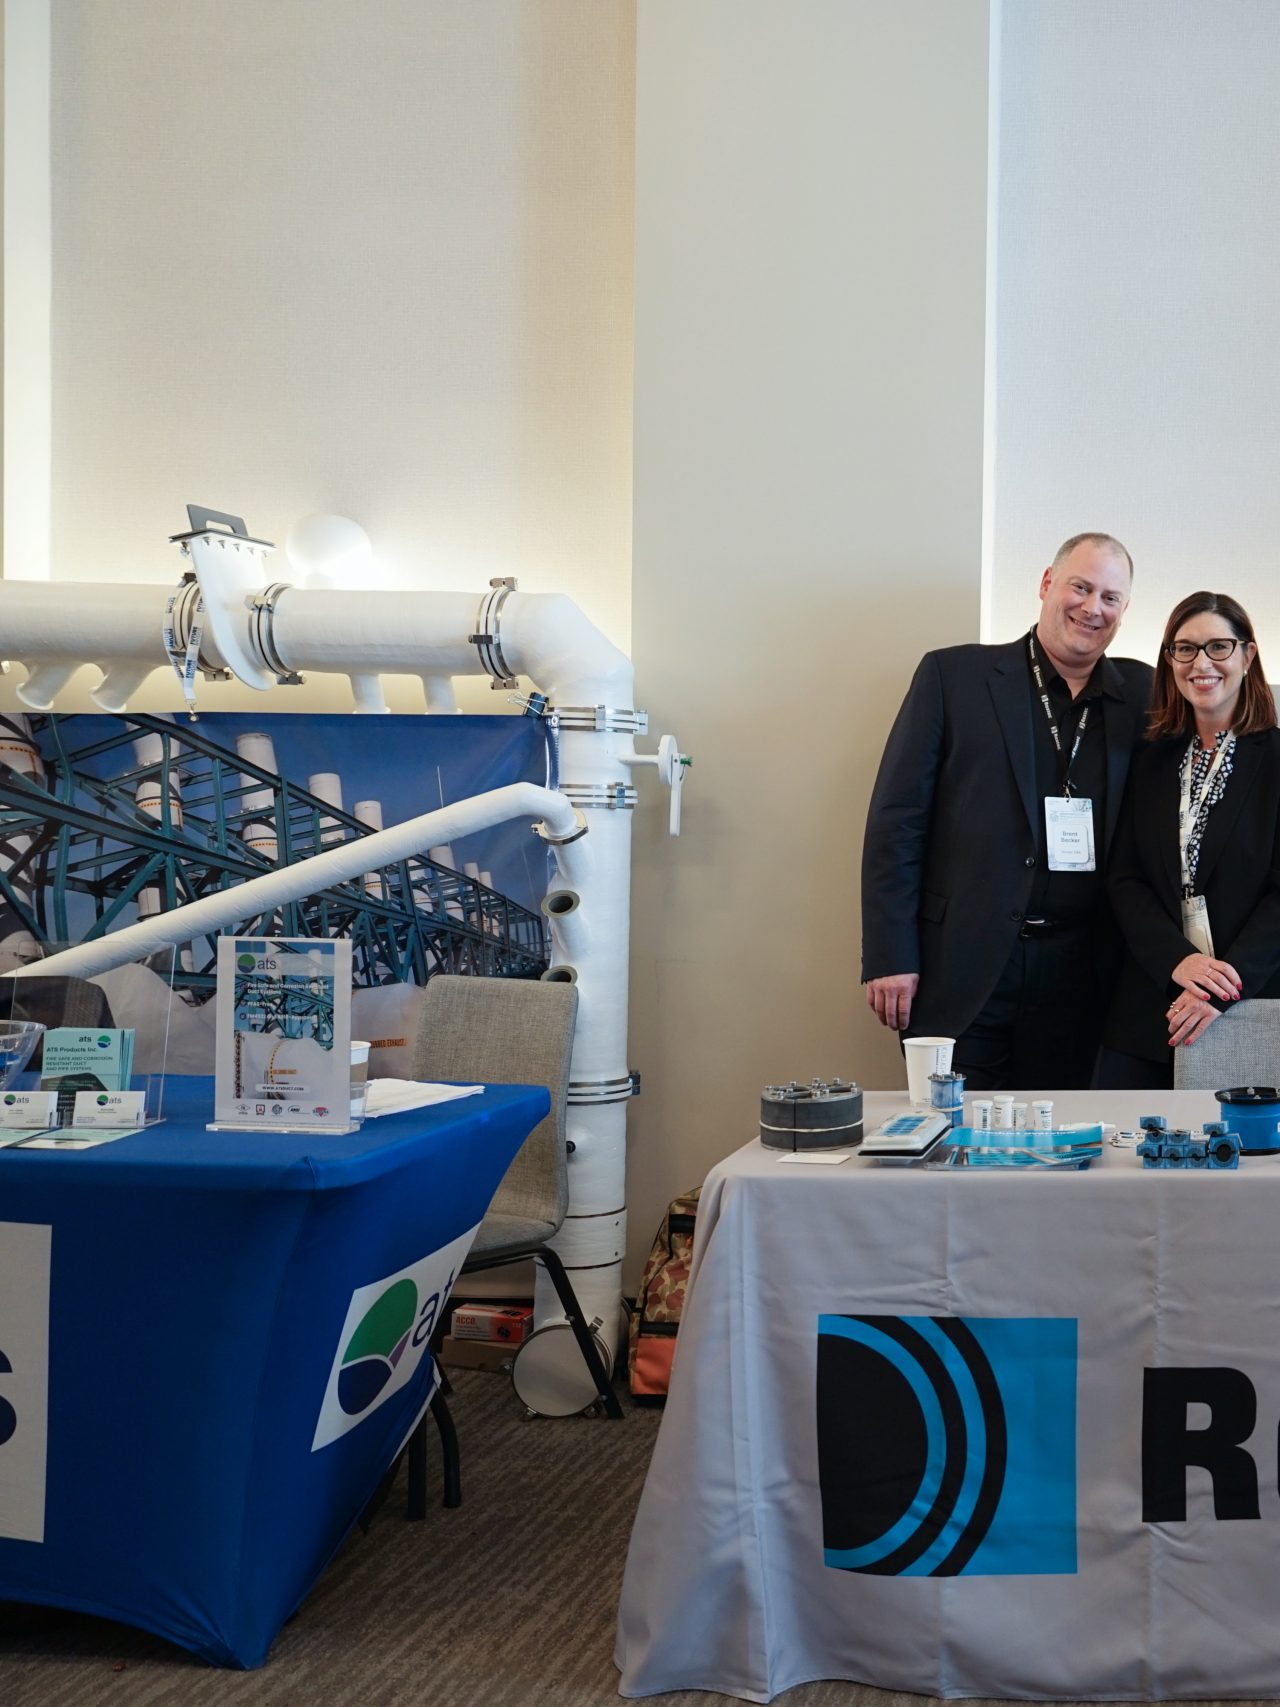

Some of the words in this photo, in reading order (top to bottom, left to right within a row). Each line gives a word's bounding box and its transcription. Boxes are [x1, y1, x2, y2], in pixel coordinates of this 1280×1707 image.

[257, 958, 277, 970] ats
[78, 1035, 92, 1043] ats
[16, 1096, 30, 1104] ats
[108, 1096, 122, 1104] ats
[412, 1267, 456, 1348] at
